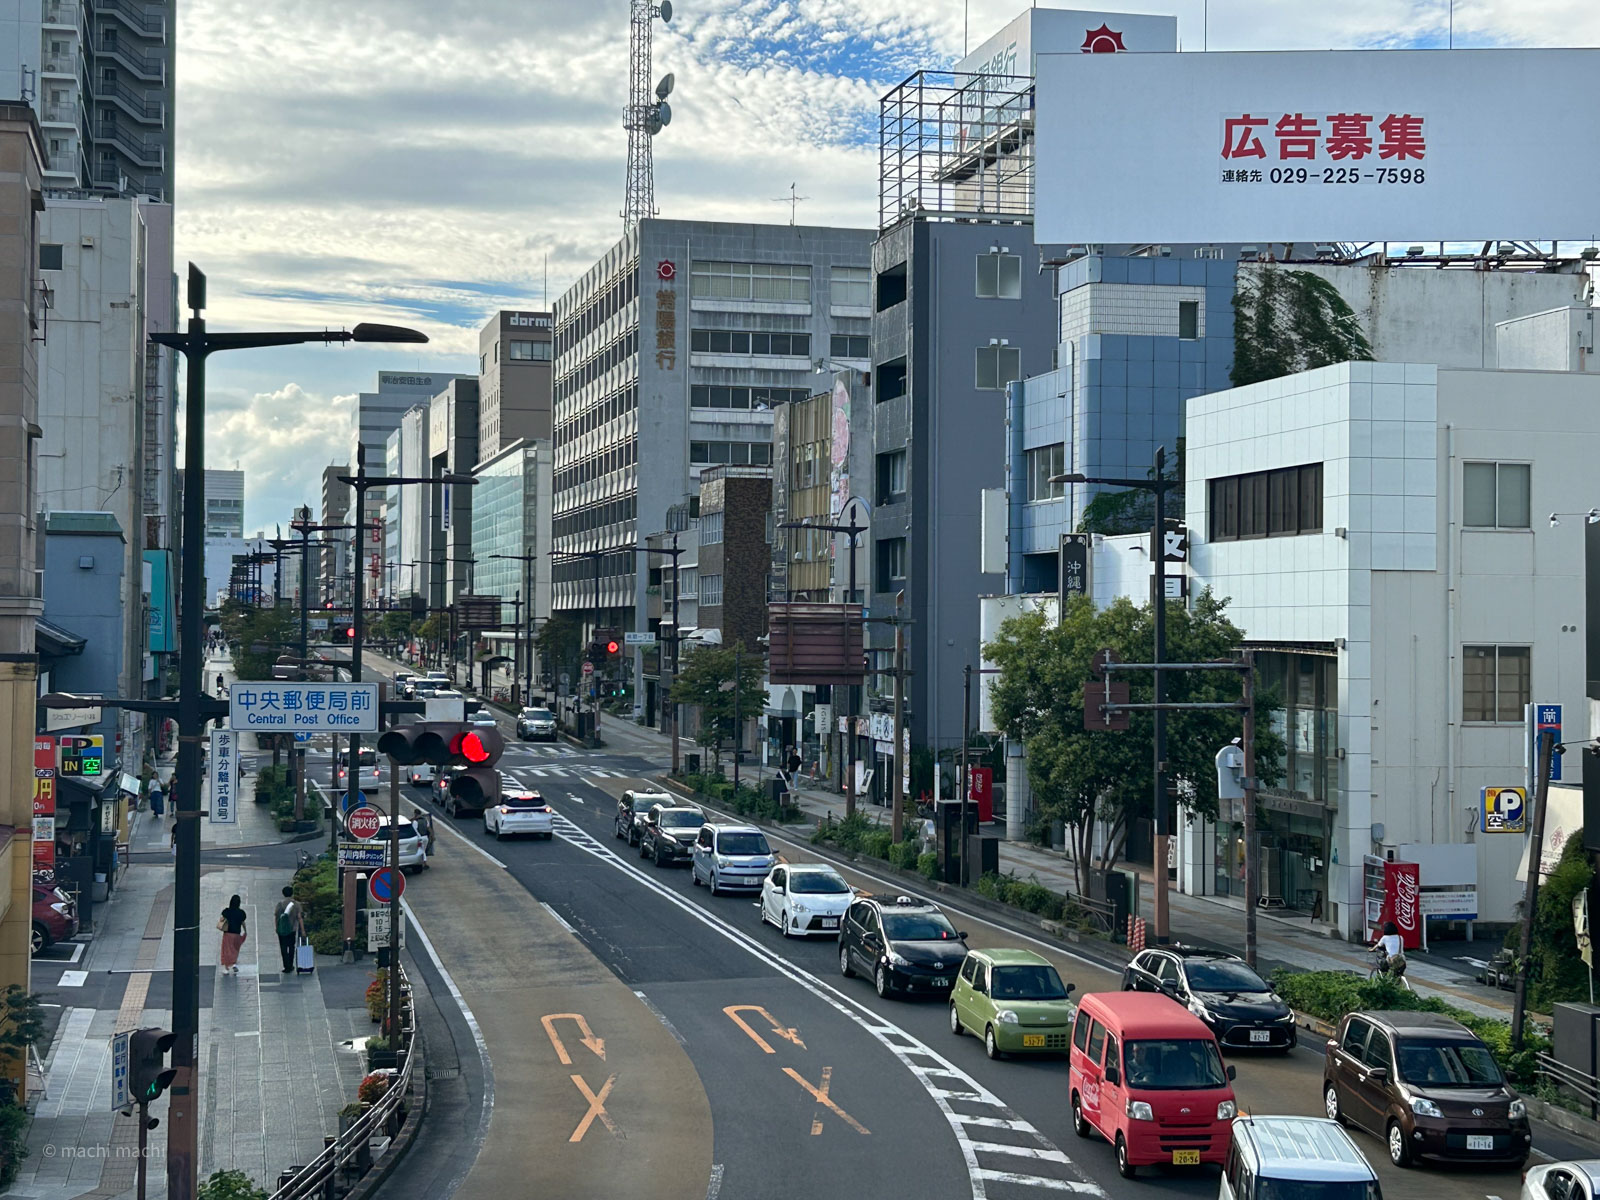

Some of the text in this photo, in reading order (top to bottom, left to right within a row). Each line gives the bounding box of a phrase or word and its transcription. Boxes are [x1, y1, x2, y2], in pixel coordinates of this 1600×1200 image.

[1221, 113, 1426, 160] 広告募集
[1222, 168, 1425, 184] 連絡先 029-225-7598
[382, 376, 433, 386] 明治安田生命
[238, 690, 370, 711] 中央郵便局前
[248, 713, 360, 724] Central Post Office
[72, 738, 93, 755] P
[64, 761, 78, 771] IN
[83, 758, 100, 773] 空
[217, 734, 230, 820] 歩車分離式信号
[1500, 792, 1521, 819] P
[352, 817, 378, 829] 消火栓
[1487, 812, 1504, 829] 空
